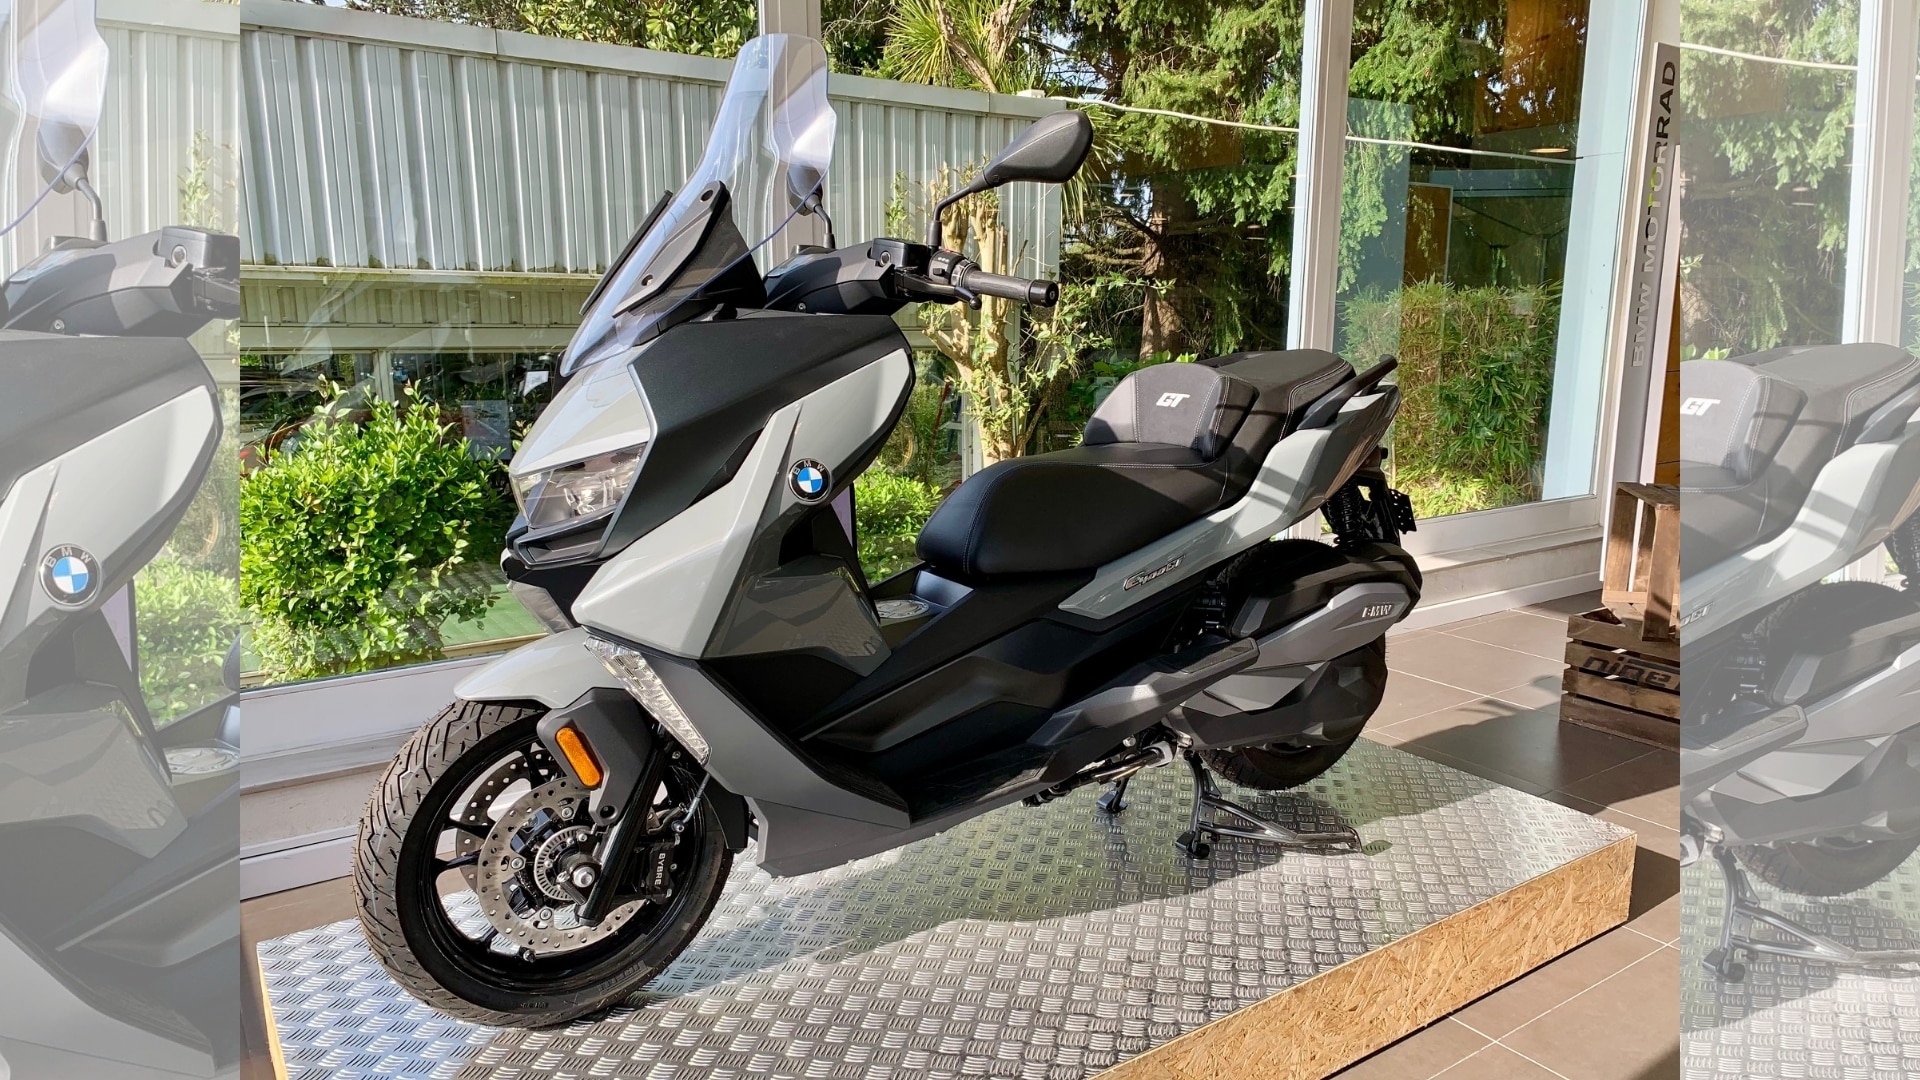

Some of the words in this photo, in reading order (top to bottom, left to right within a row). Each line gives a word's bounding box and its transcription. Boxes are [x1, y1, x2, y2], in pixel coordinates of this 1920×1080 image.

[1632, 283, 1652, 367] BMW
[1642, 61, 1676, 273] MOTORRAD
[1156, 392, 1191, 408] GT
[1680, 397, 1721, 416] GT
[792, 459, 826, 475] BMW
[45, 546, 92, 568] BMW
[654, 852, 666, 887] BYBRE
